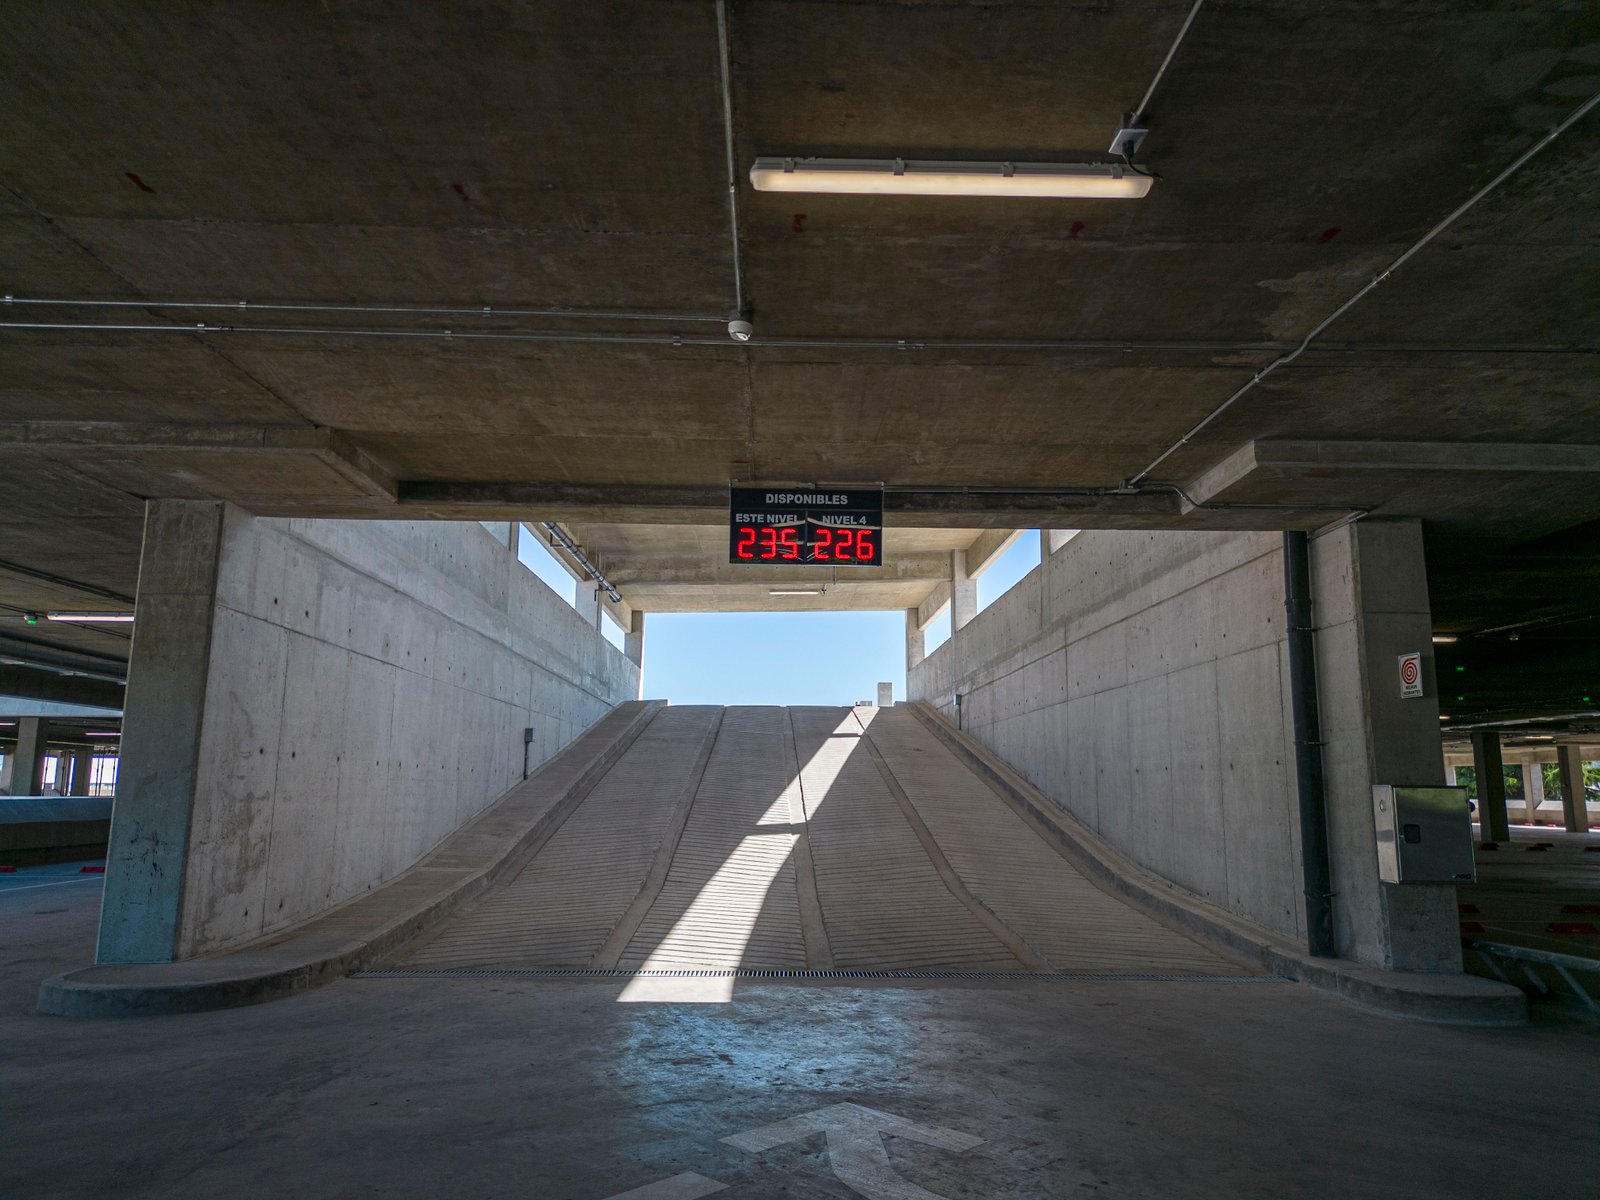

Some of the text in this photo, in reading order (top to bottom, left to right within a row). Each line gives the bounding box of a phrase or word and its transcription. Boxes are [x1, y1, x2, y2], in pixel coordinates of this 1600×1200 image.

[765, 493, 849, 505] DISPONIBLES
[735, 513, 800, 523] ESTE NIVEL
[822, 515, 867, 525] NIVEL 4
[737, 527, 799, 559] 235
[814, 528, 875, 560] 226
